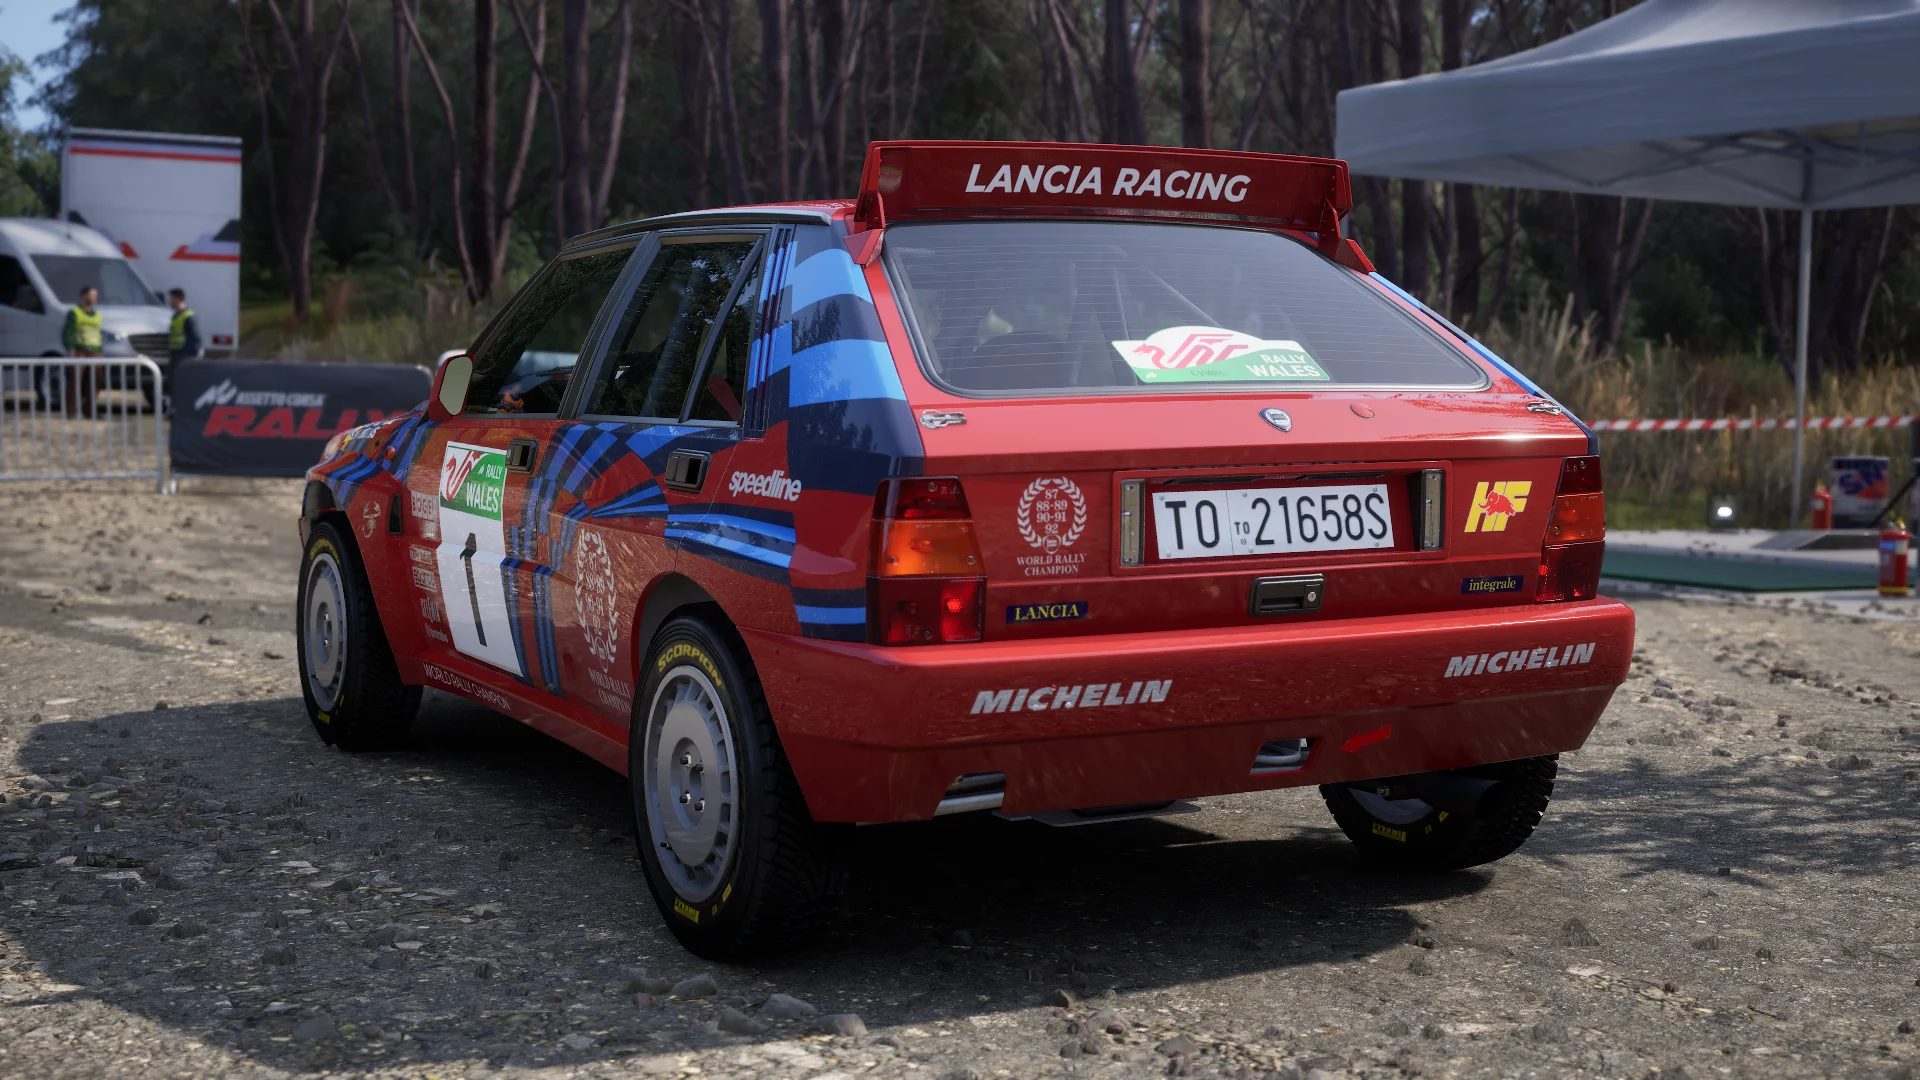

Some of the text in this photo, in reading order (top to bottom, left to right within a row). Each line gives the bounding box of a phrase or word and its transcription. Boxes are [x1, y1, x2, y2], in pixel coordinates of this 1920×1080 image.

[965, 163, 1251, 203] LANCIA RACING
[1259, 353, 1306, 364] RALLY
[1190, 369, 1228, 378] CYMRU
[1246, 364, 1321, 378] WALES
[485, 463, 503, 480] RALLY
[728, 469, 802, 502] speedline
[1045, 488, 1059, 500] 87
[466, 482, 500, 513] WALES
[1036, 499, 1068, 511] 88-89
[1464, 481, 1533, 533] HF
[1036, 511, 1067, 523] 90-91
[1165, 492, 1388, 550] TO TO 21658S
[1045, 523, 1059, 534] 92
[1016, 553, 1086, 566] WORLD RALLY
[1024, 564, 1079, 577] CHAMPION
[459, 533, 487, 647] 1
[1468, 576, 1517, 592] integrale
[1015, 603, 1079, 621] LANCIA
[657, 643, 723, 688] SCORPION
[1444, 642, 1597, 679] MICHELIN
[422, 662, 452, 685] WORLD
[450, 674, 473, 693] RALLY
[969, 679, 1173, 715] MICHELIN
[1371, 822, 1407, 843] PIRELLI
[673, 897, 700, 924] PIRELLI
